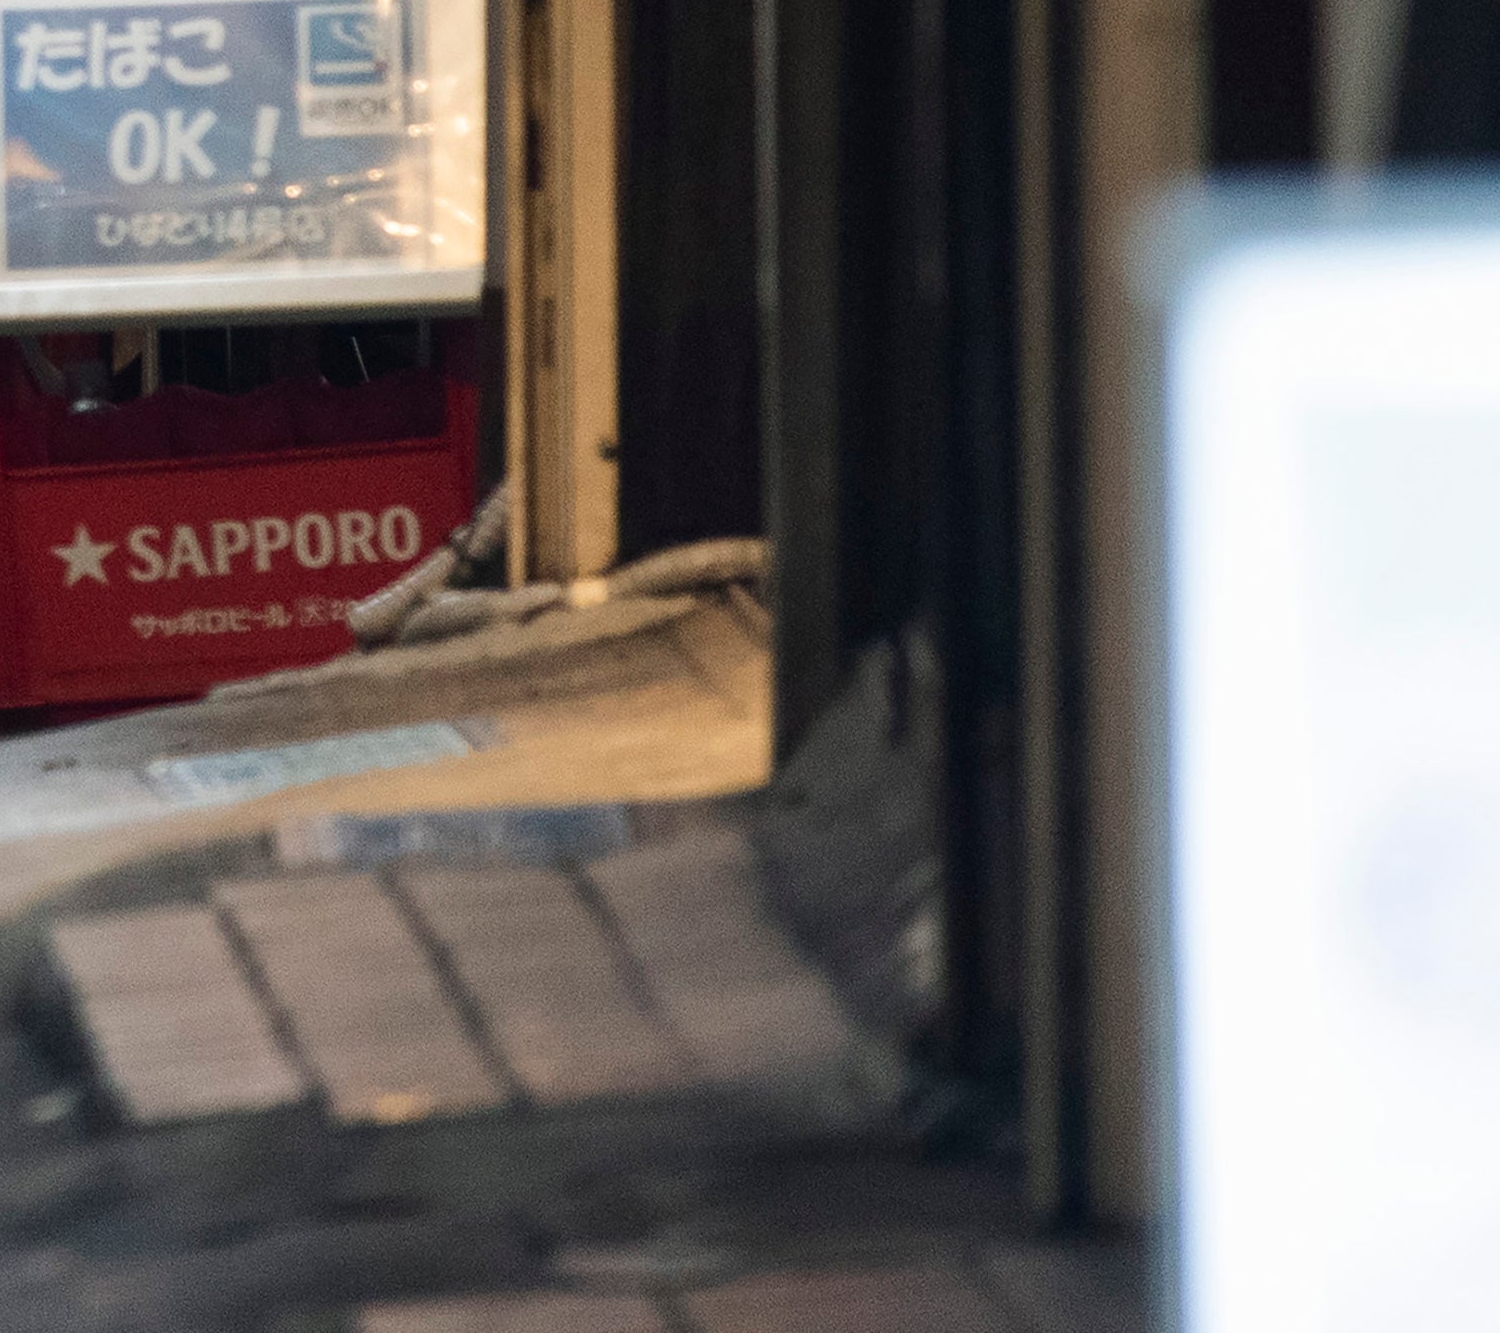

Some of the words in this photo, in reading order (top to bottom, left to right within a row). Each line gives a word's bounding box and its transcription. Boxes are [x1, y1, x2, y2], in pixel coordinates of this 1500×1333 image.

[15, 17, 232, 91] たばこ
[126, 505, 423, 583] SAPPORO
